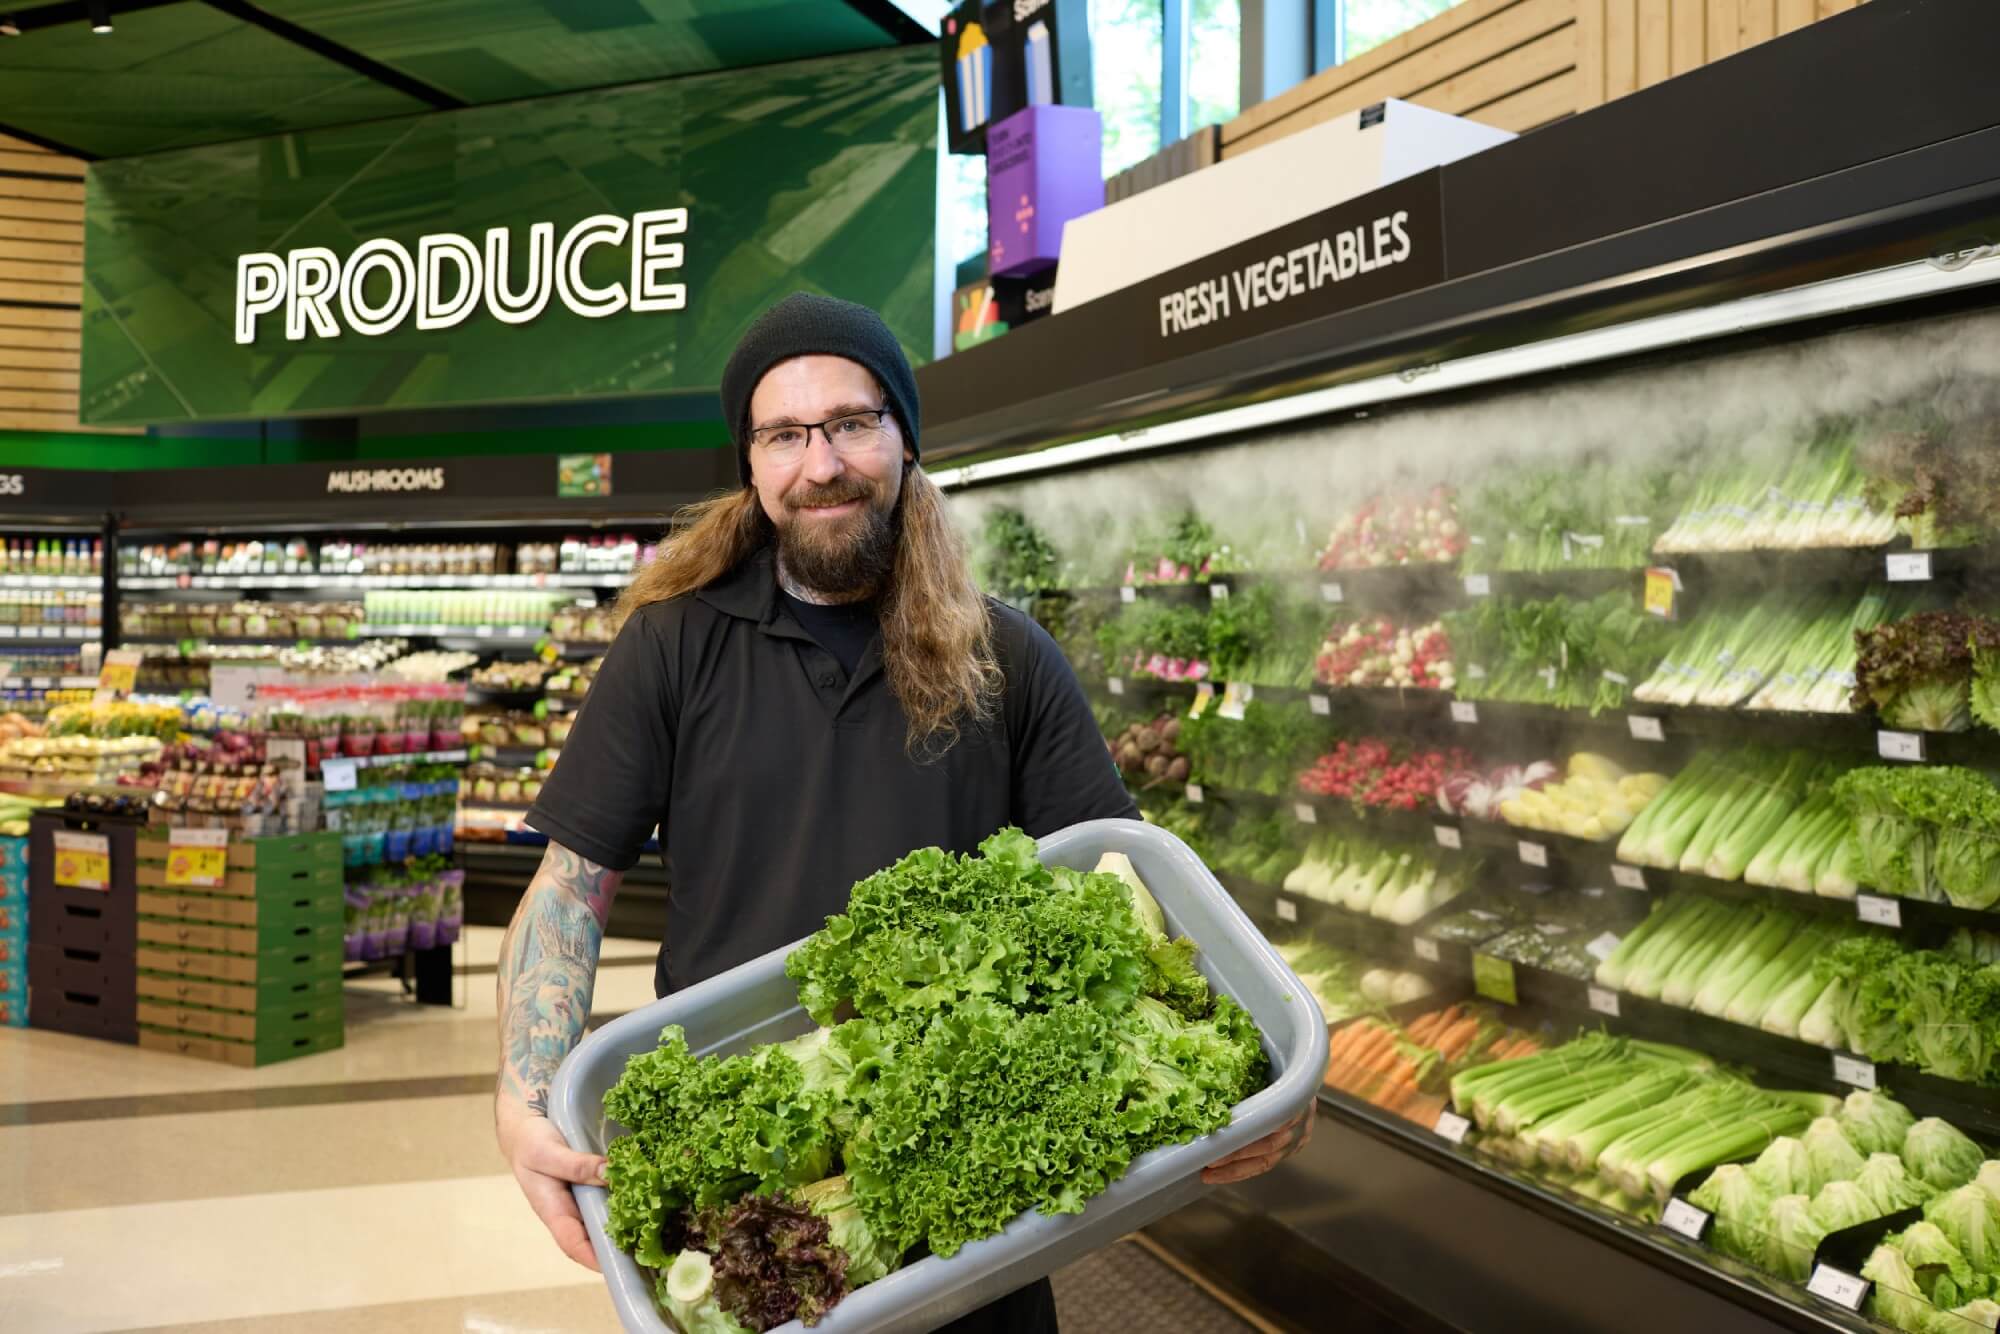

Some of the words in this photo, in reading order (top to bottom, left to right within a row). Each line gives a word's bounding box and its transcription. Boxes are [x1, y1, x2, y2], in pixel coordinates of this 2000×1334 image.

[235, 207, 688, 345] PRODUCE
[1159, 274, 1231, 338] FRESH
[1232, 210, 1411, 312] VEGETABLES
[327, 467, 445, 493] MUSHROOMS
